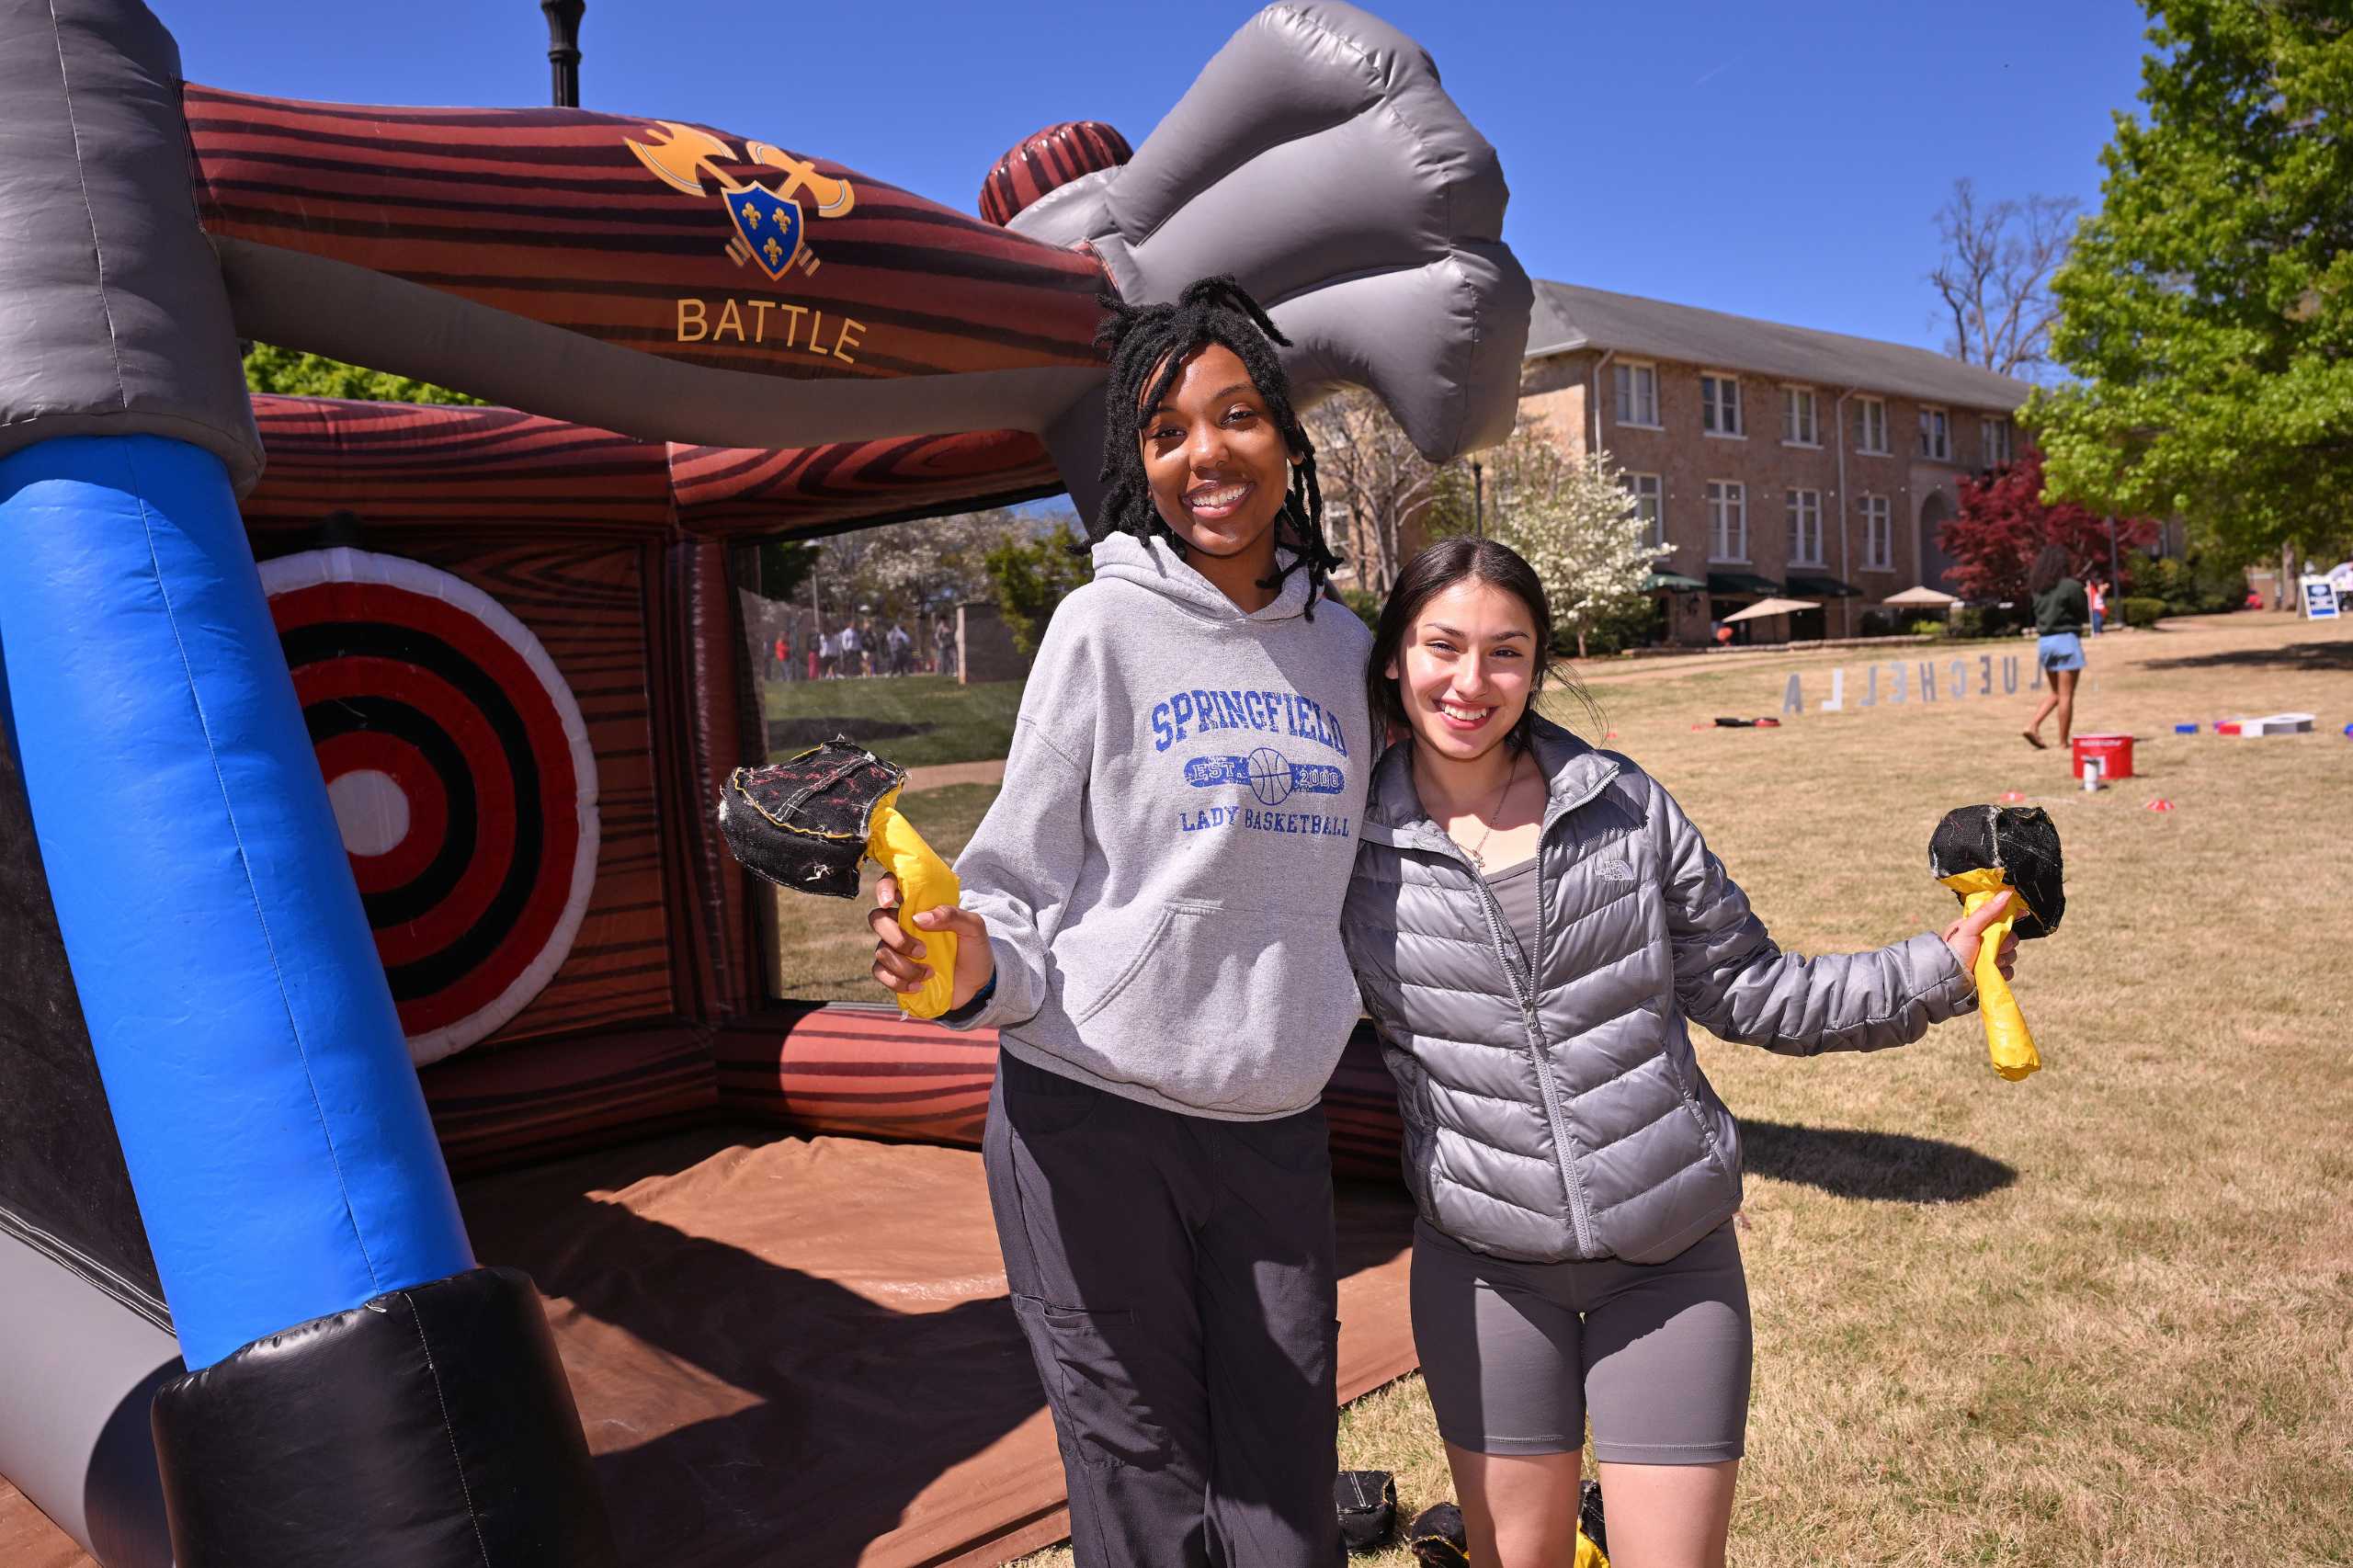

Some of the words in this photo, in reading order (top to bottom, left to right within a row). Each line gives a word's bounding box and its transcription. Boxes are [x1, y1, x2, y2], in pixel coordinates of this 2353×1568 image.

[676, 298, 867, 365] BATTLE
[1151, 689, 1347, 758] SPRINGFIELD
[1299, 769, 1339, 789] 2006
[1179, 805, 1239, 832] LADY
[1245, 808, 1349, 837] BASKETBALL
